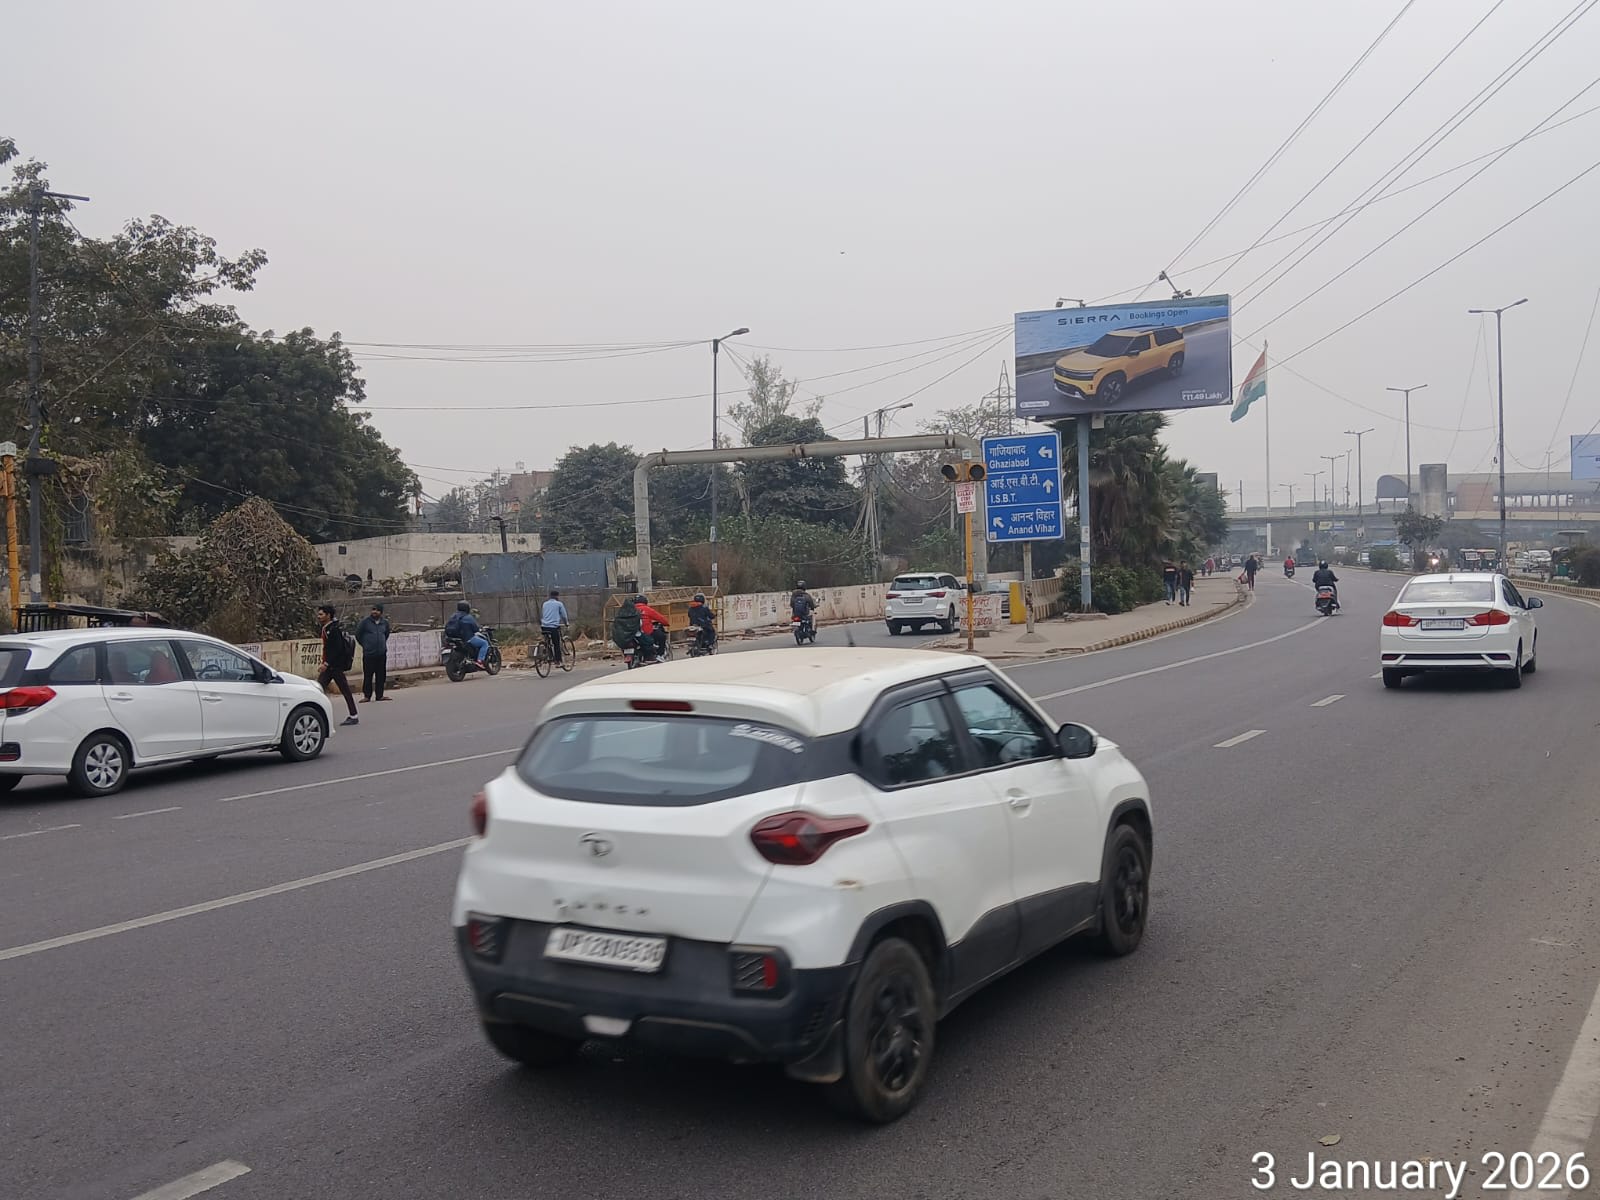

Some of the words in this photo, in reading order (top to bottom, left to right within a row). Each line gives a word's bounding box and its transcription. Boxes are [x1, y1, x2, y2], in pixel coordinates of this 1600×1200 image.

[1058, 314, 1121, 326] SIERRA
[1129, 311, 1165, 320] Bookings
[1167, 309, 1188, 318] Open
[989, 444, 1026, 457] गाजियाबाद
[989, 458, 1030, 469] Ghaziabad
[991, 493, 1017, 504] I.S.B.T.
[1011, 511, 1034, 523] आनन्द
[1036, 508, 1055, 522] विहार
[1008, 525, 1033, 535] Anand
[1035, 523, 1056, 534] Vihar
